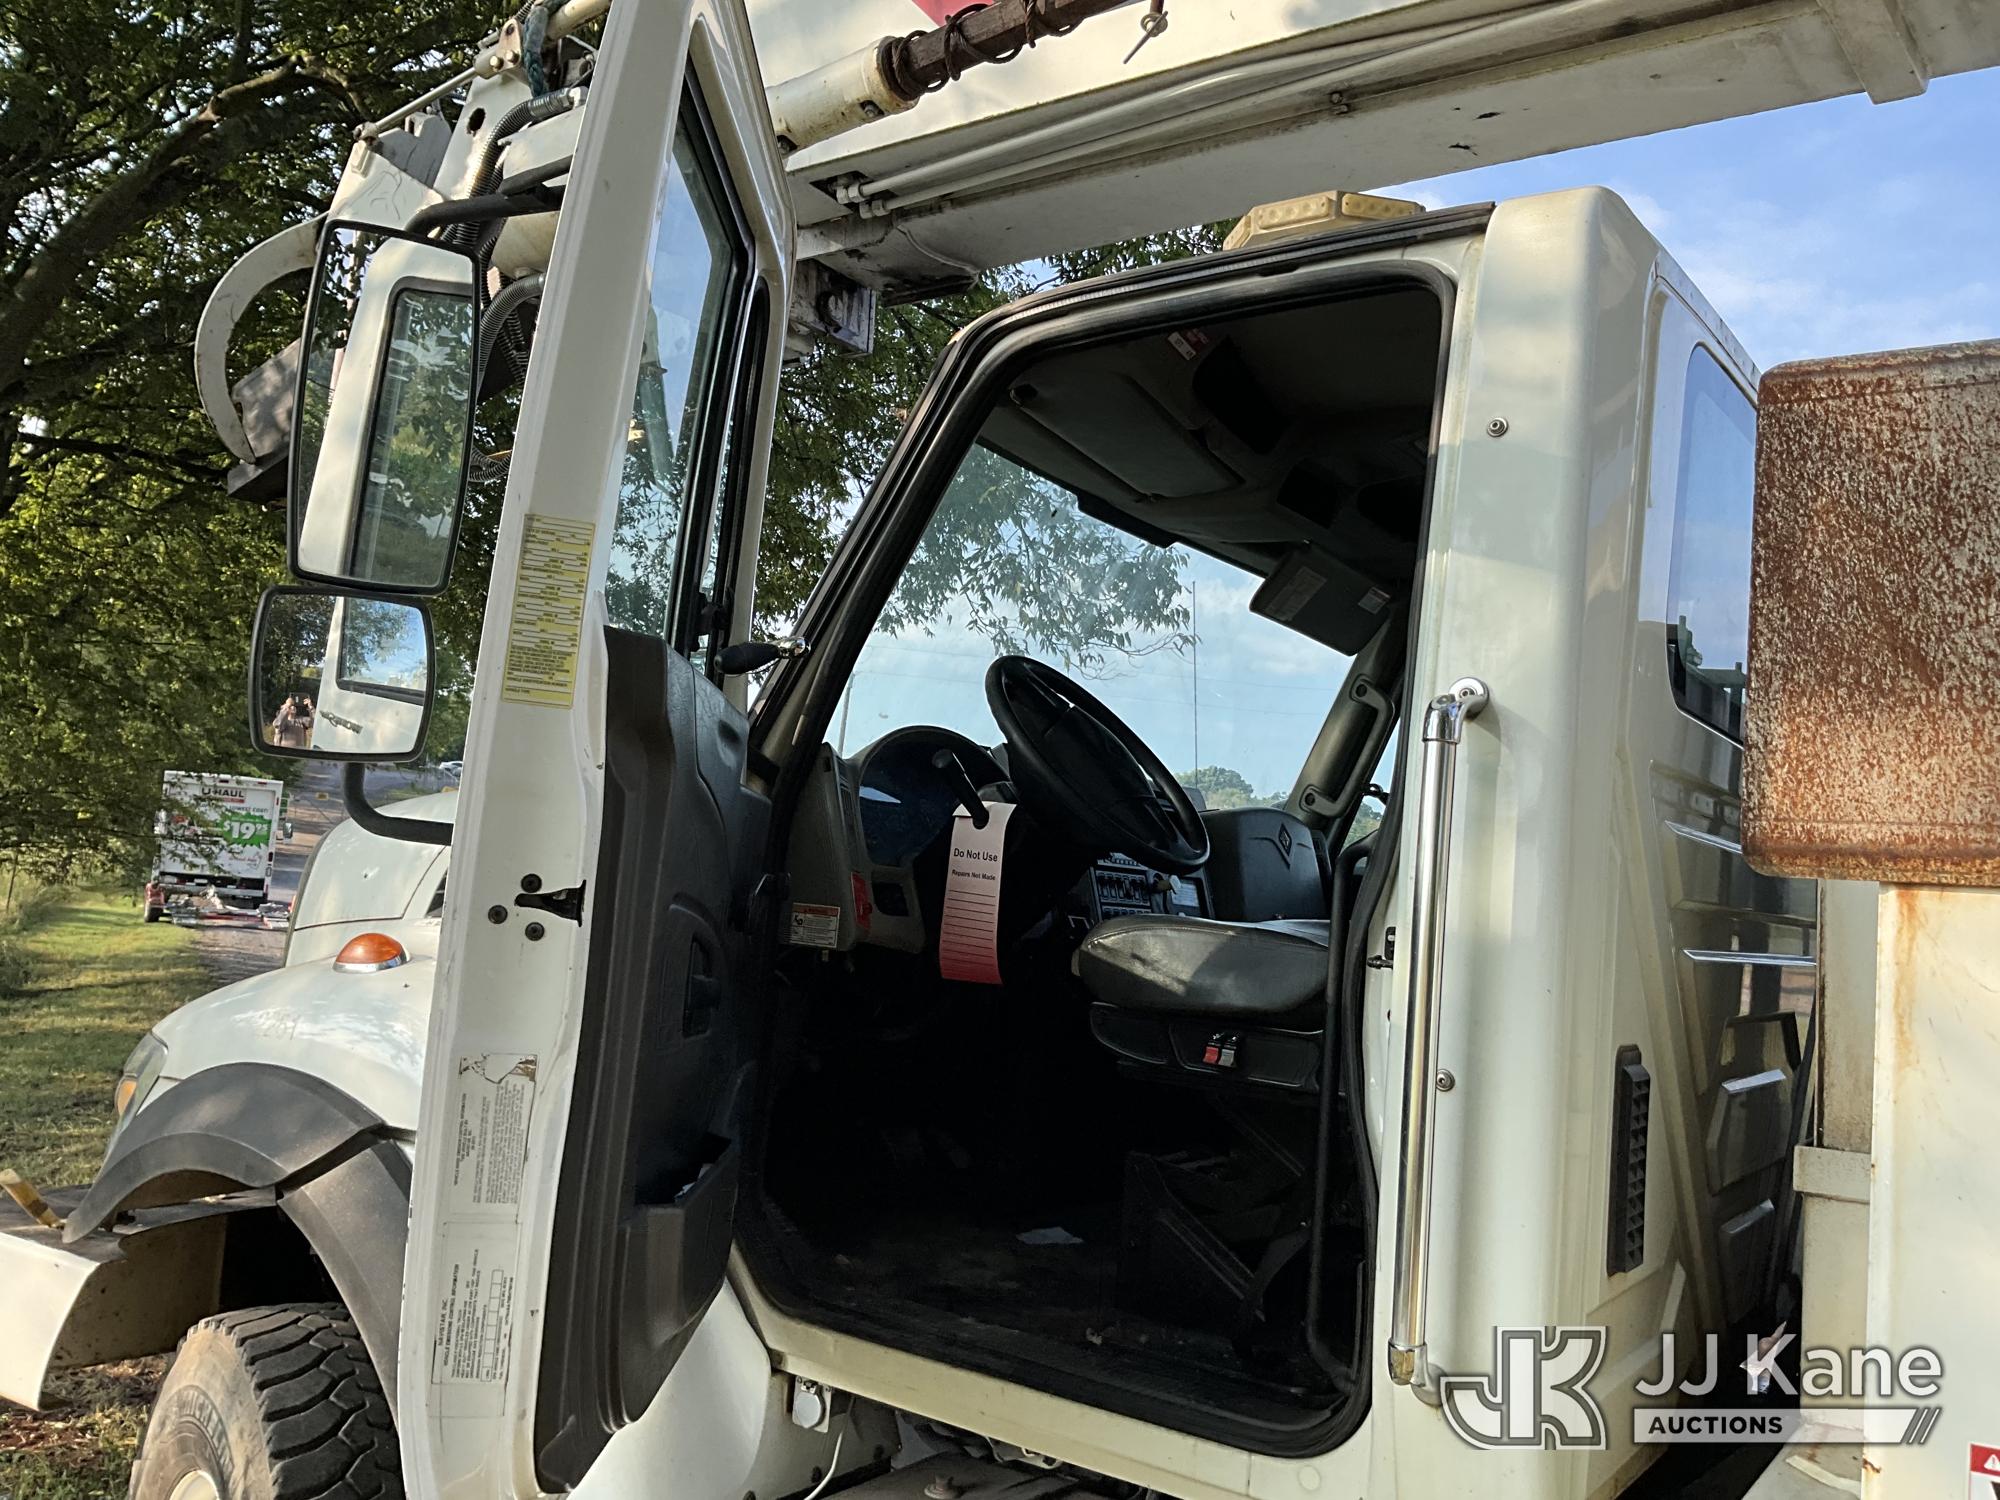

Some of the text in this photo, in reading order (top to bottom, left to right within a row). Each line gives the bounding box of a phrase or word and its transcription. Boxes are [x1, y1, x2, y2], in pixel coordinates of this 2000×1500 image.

[202, 787, 245, 798] U-HAUL
[953, 848, 998, 862] Do Not Use
[952, 869, 996, 881] Repairs Not Made
